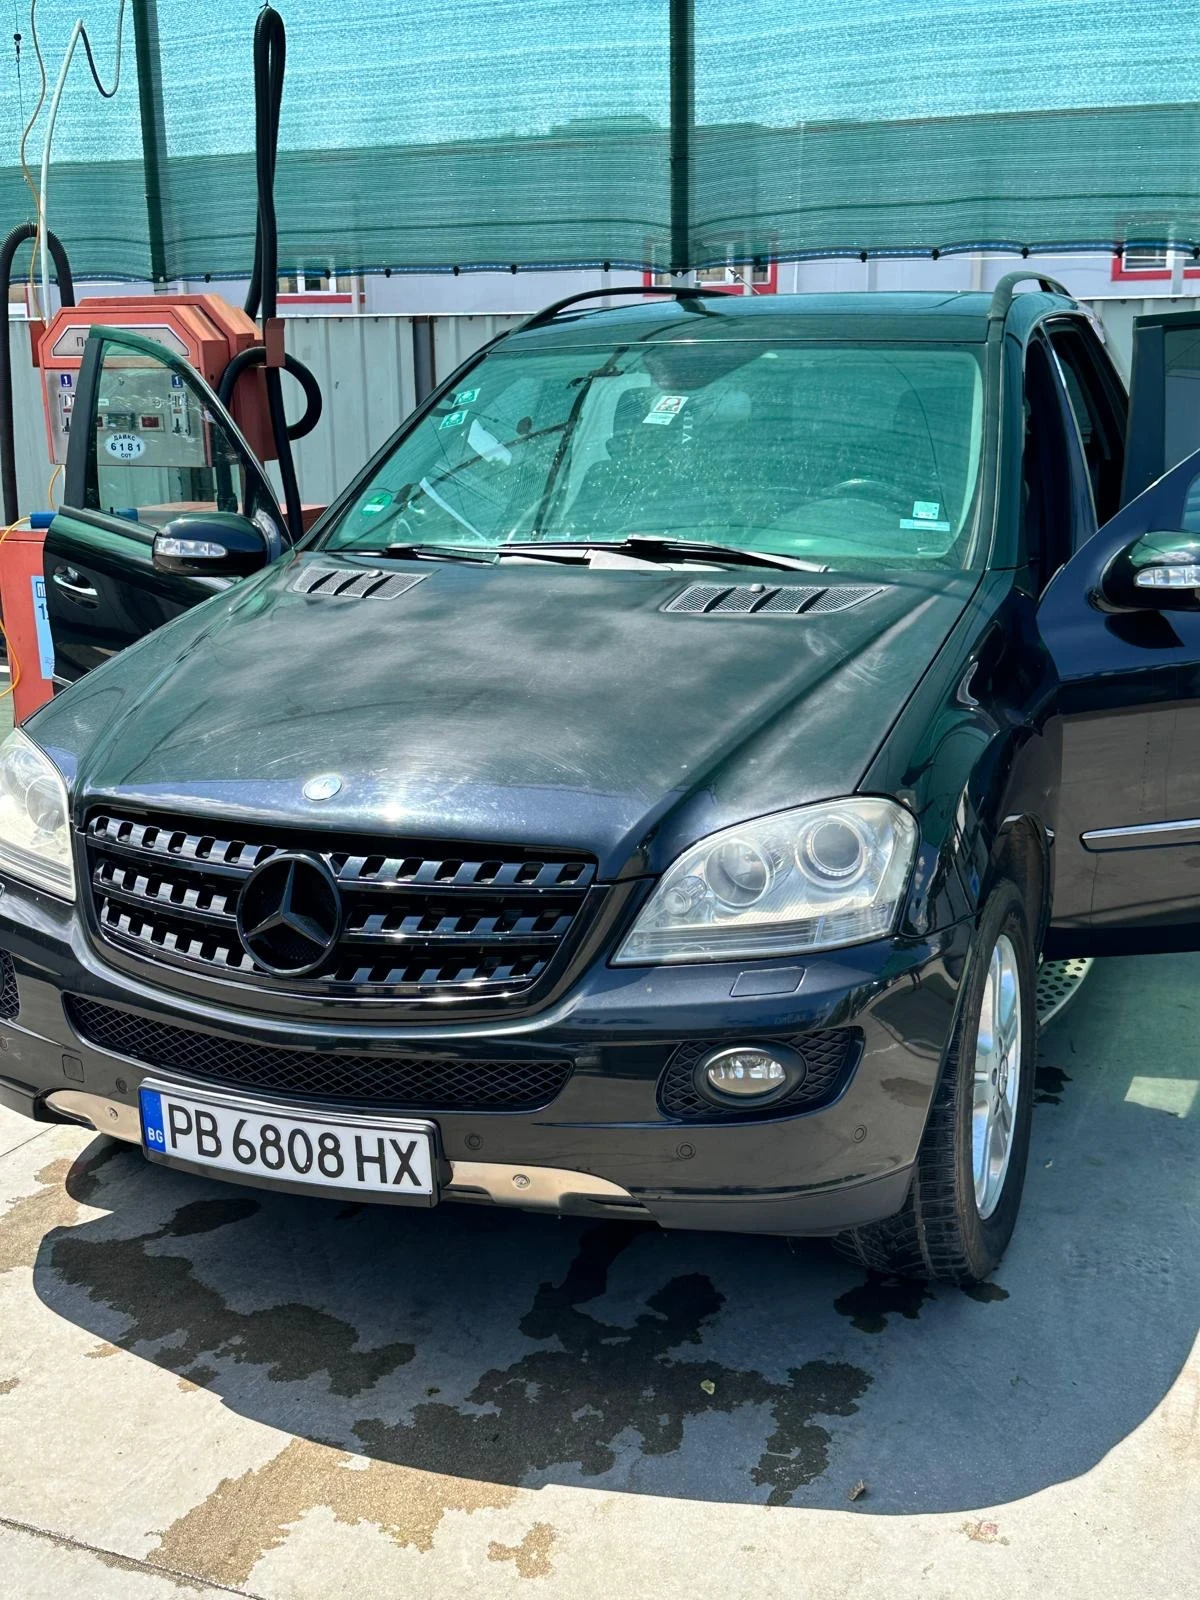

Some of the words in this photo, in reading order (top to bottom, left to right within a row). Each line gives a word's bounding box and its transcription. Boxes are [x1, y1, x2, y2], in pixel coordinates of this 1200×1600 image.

[682, 410, 693, 444] VIP
[110, 442, 141, 452] 6181
[147, 1127, 164, 1144] BG
[168, 1103, 222, 1158] PB
[232, 1118, 345, 1178] 6808
[354, 1135, 422, 1187] HX
